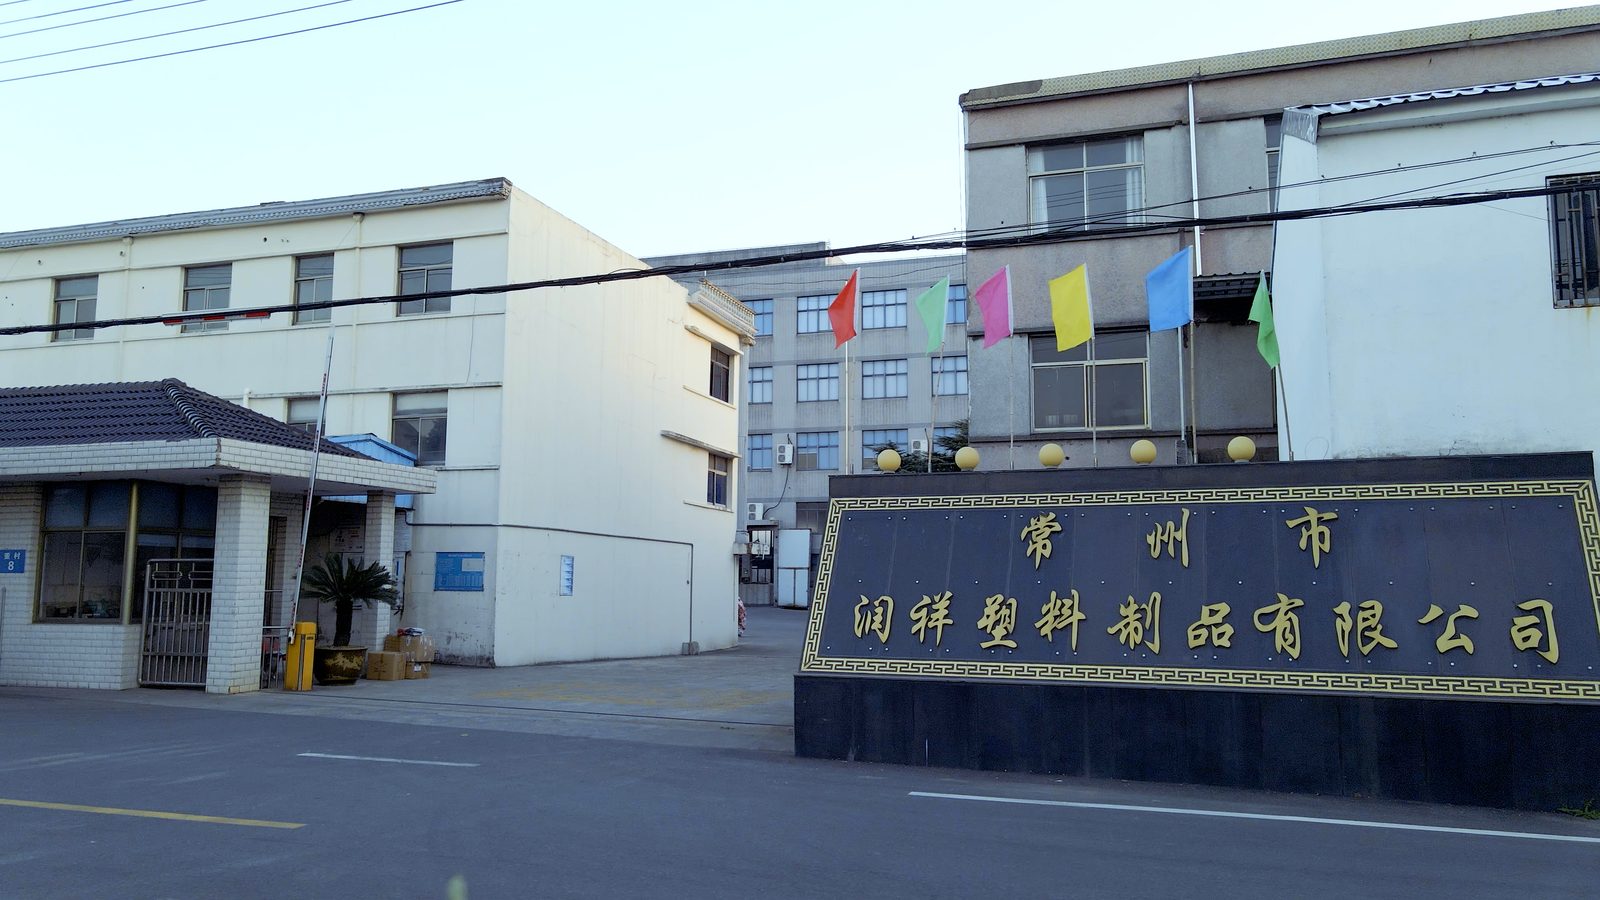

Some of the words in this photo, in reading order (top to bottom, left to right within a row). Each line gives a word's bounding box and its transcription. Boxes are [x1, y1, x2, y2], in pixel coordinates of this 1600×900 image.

[8, 560, 15, 571] 8
[1020, 506, 1338, 569] 常州市
[853, 589, 1560, 664] 润祥塑料制品有限公司
